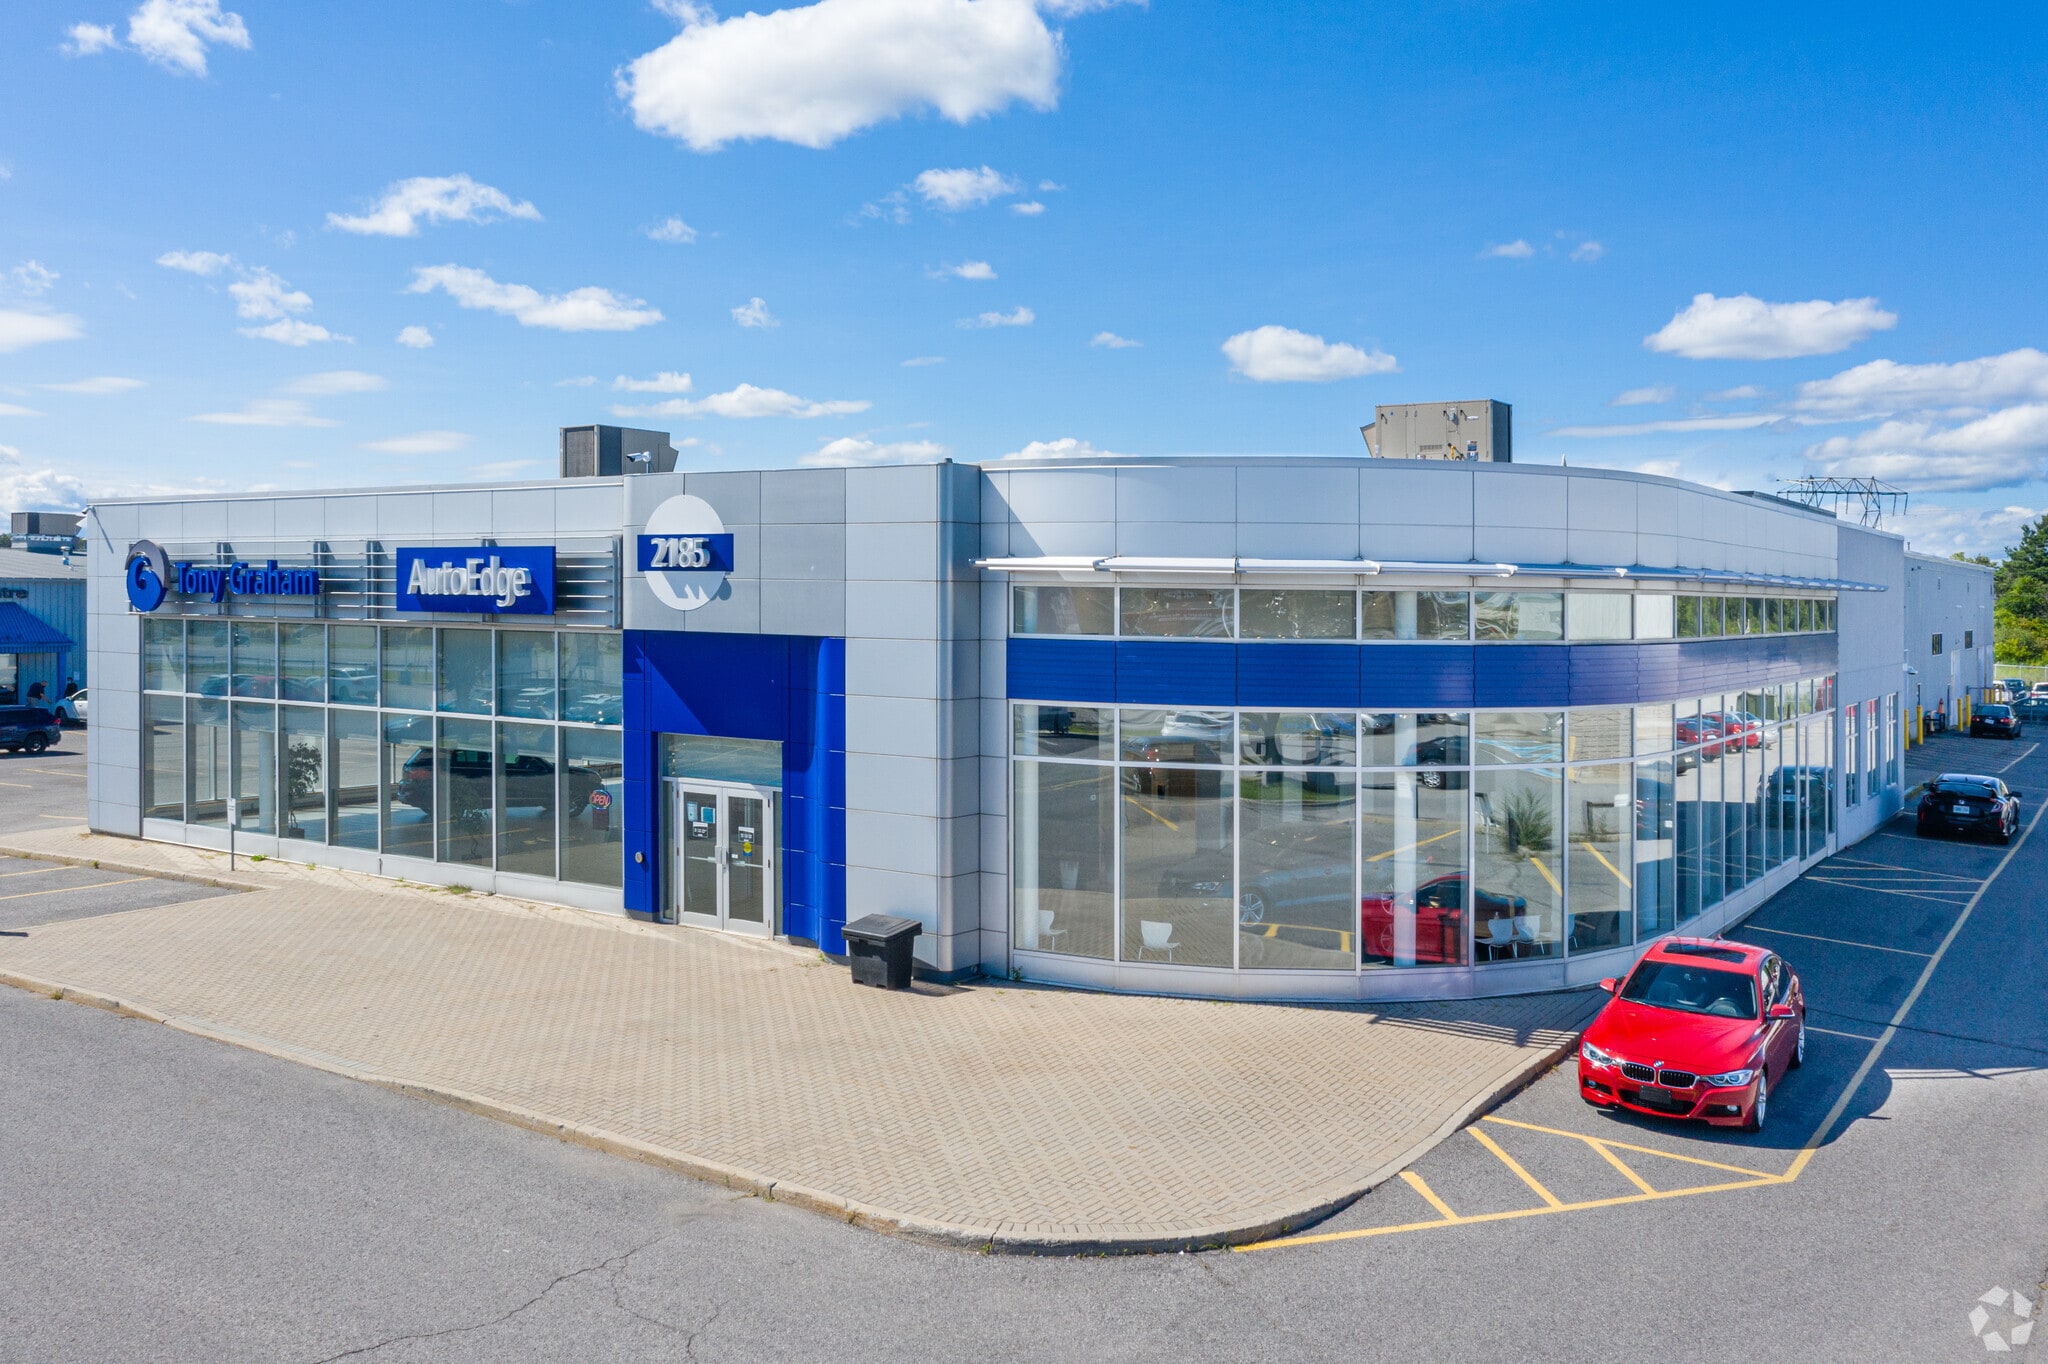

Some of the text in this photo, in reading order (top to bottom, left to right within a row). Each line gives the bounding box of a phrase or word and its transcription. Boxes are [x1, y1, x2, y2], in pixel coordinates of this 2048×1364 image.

[650, 537, 711, 568] 2185
[174, 560, 320, 604] Tony Graham
[407, 555, 532, 607] AutoEdge
[590, 793, 610, 806] OPEN
